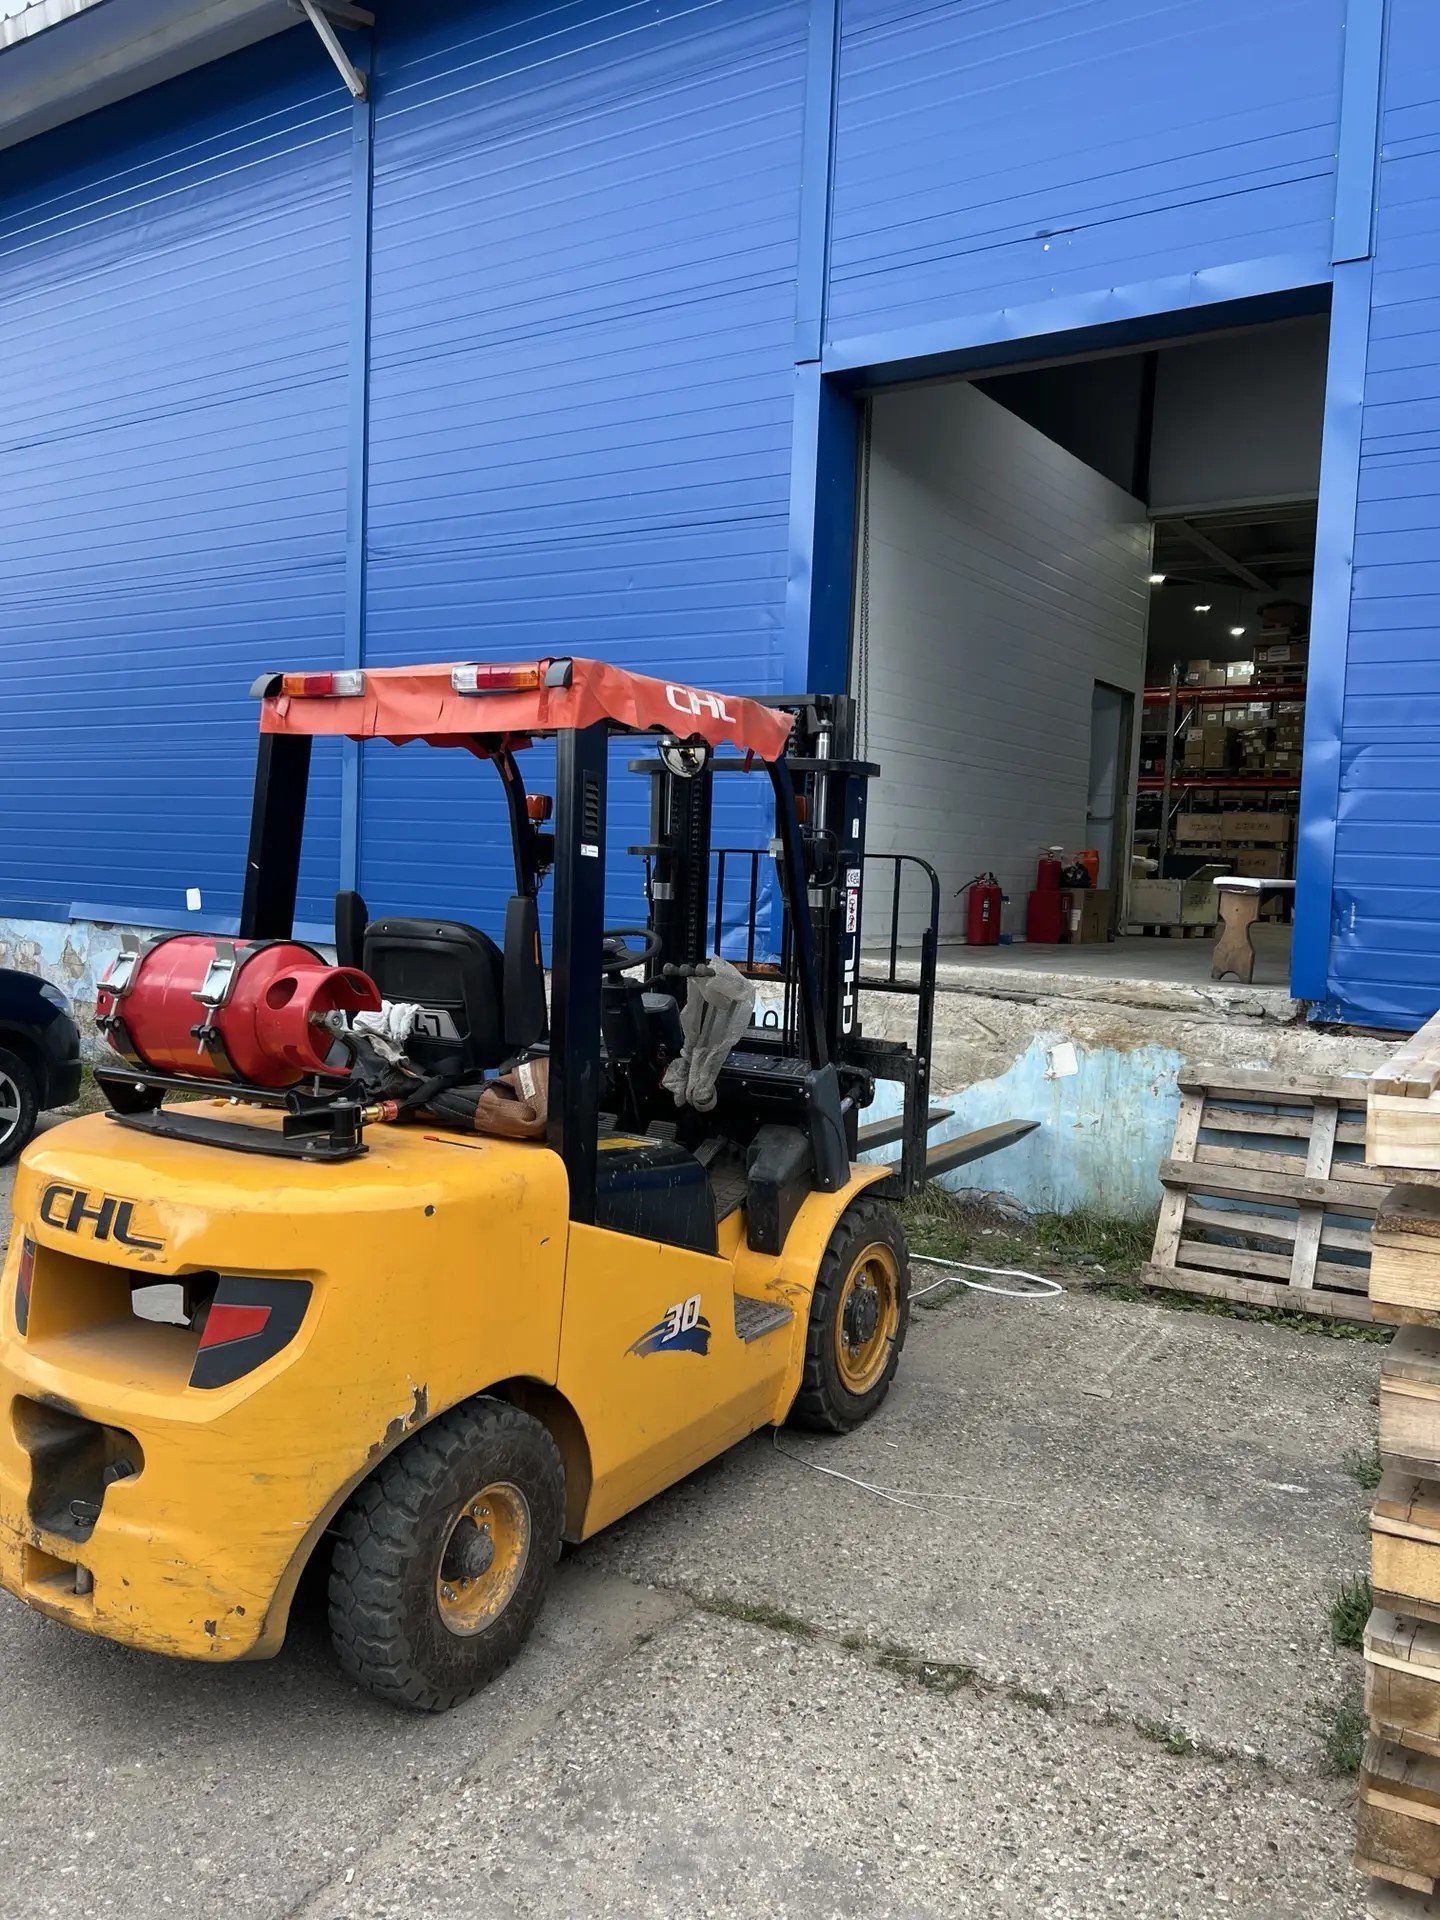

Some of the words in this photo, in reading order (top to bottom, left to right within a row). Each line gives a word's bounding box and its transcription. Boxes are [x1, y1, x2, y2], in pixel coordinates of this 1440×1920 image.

[666, 685, 736, 723] CHL
[843, 936, 856, 1034] CHL
[41, 1186, 162, 1249] CHL
[662, 1294, 701, 1343] 30
